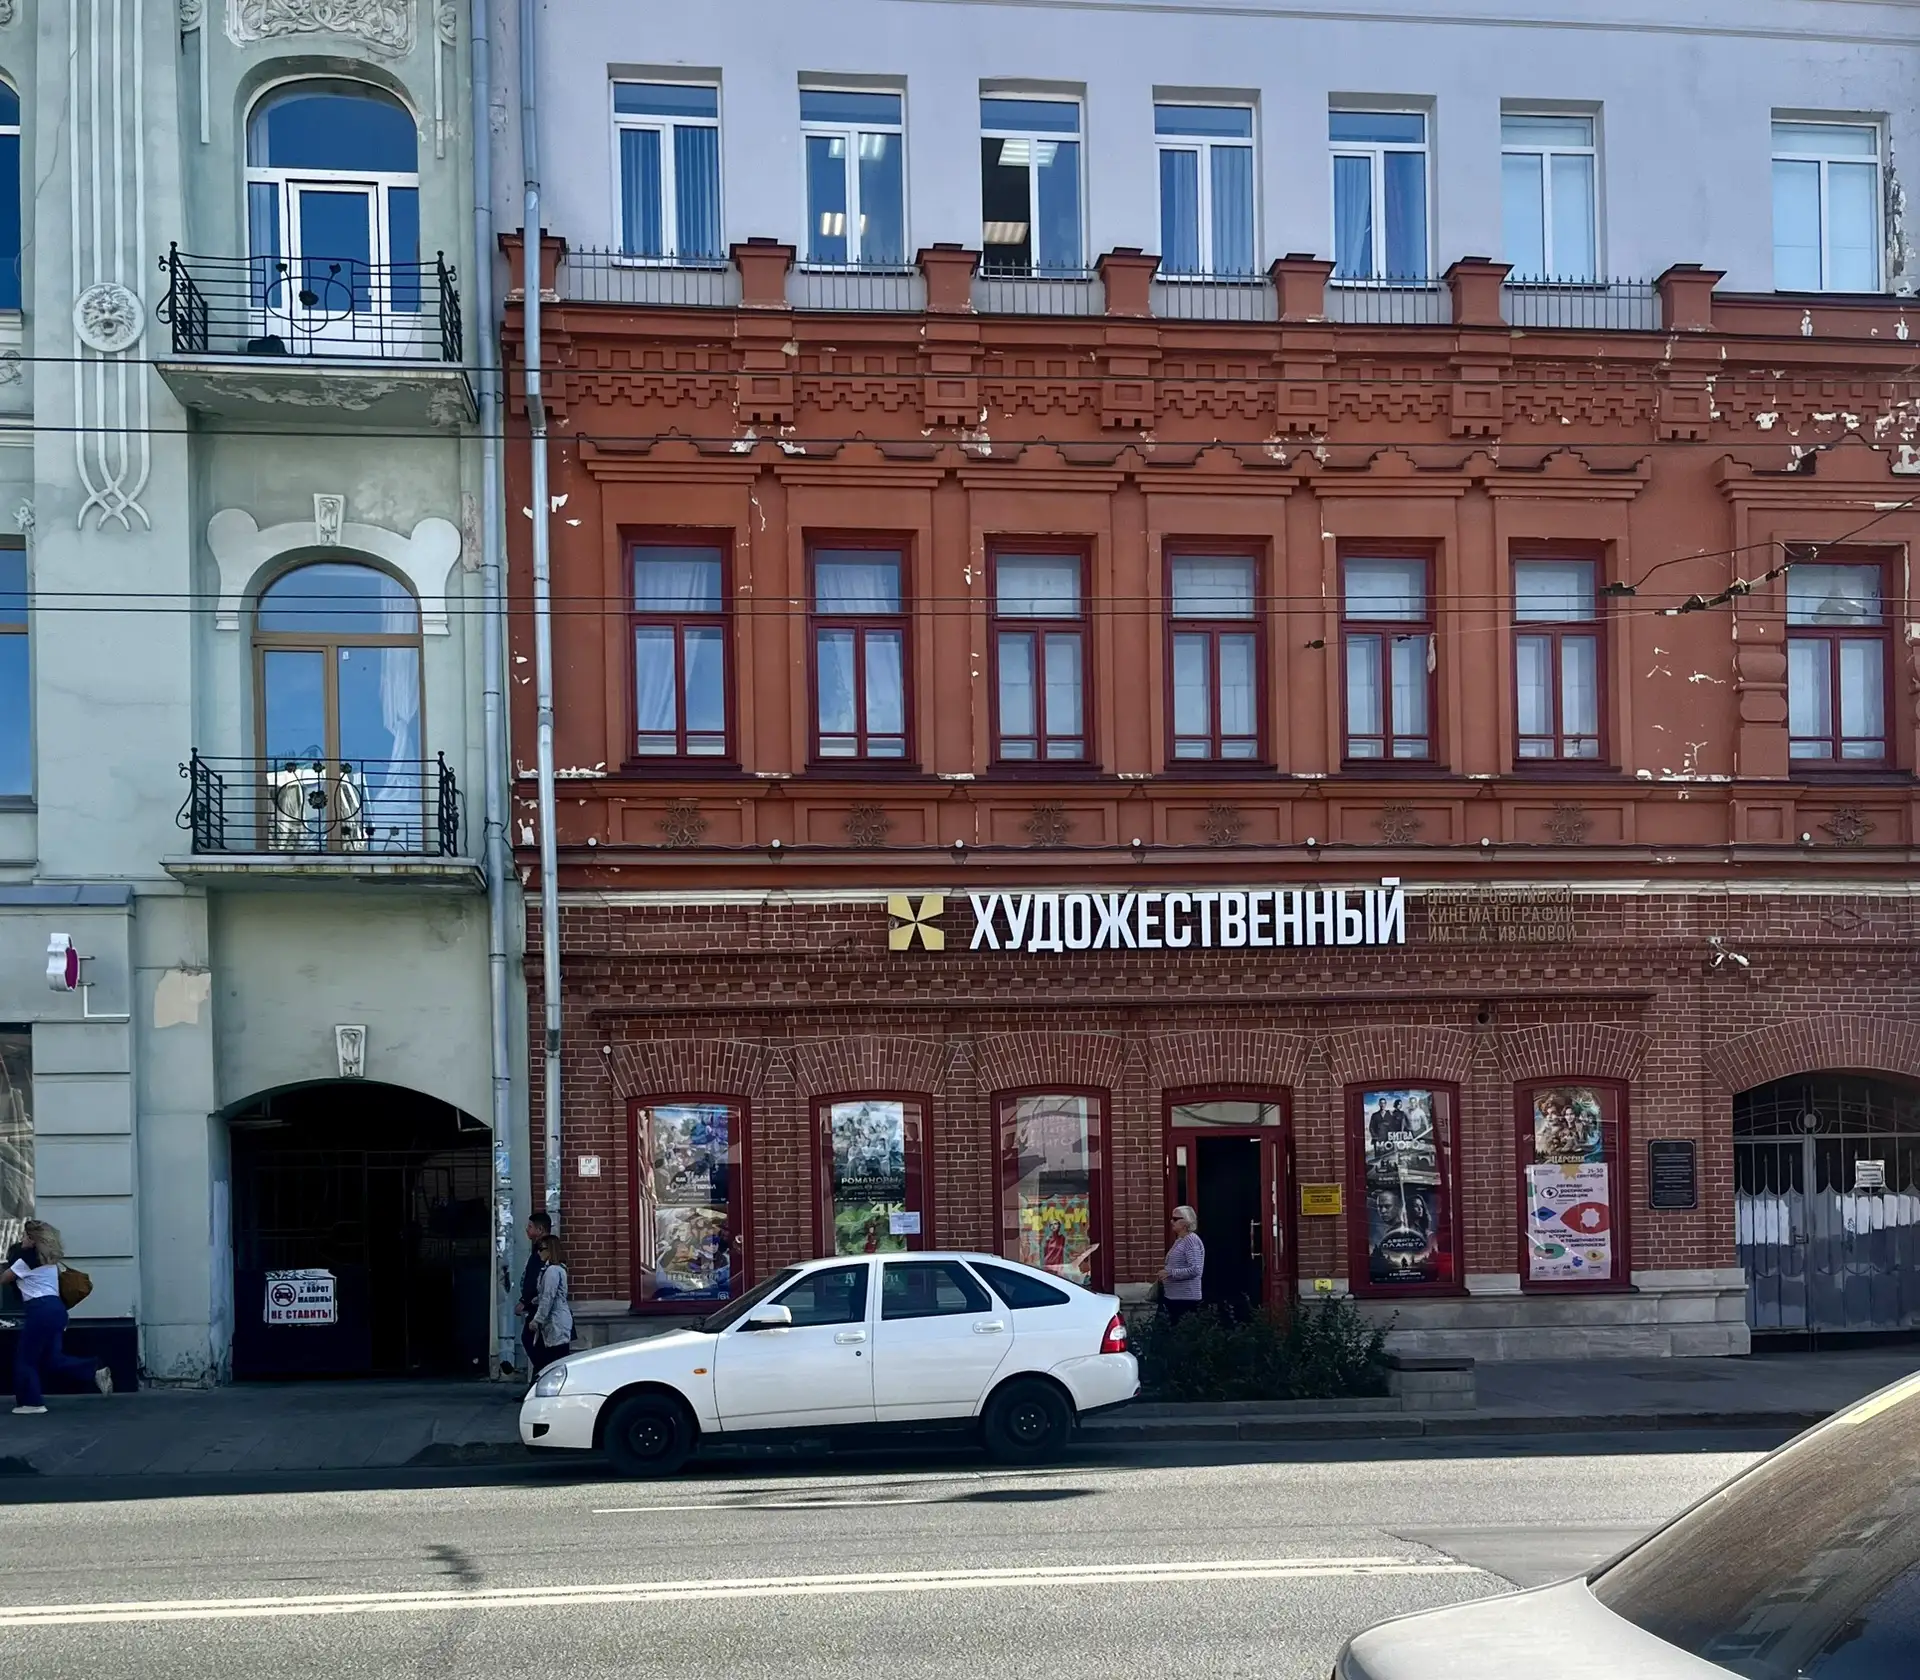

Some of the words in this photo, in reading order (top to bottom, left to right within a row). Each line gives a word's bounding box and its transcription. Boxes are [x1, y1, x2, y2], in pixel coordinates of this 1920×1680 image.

[1428, 888, 1474, 905] ЦЕНТР
[1480, 887, 1574, 904] РОССИЙСКОЙ
[970, 877, 1405, 952] ХУДОЖЕСТВЕННЫЙ
[1428, 906, 1575, 924] КИНЕМАТОГРАФИИ
[1500, 923, 1575, 943] ИВАНОВОЙ
[1387, 1131, 1413, 1140] БИТВА
[271, 1310, 282, 1319] НЕ
